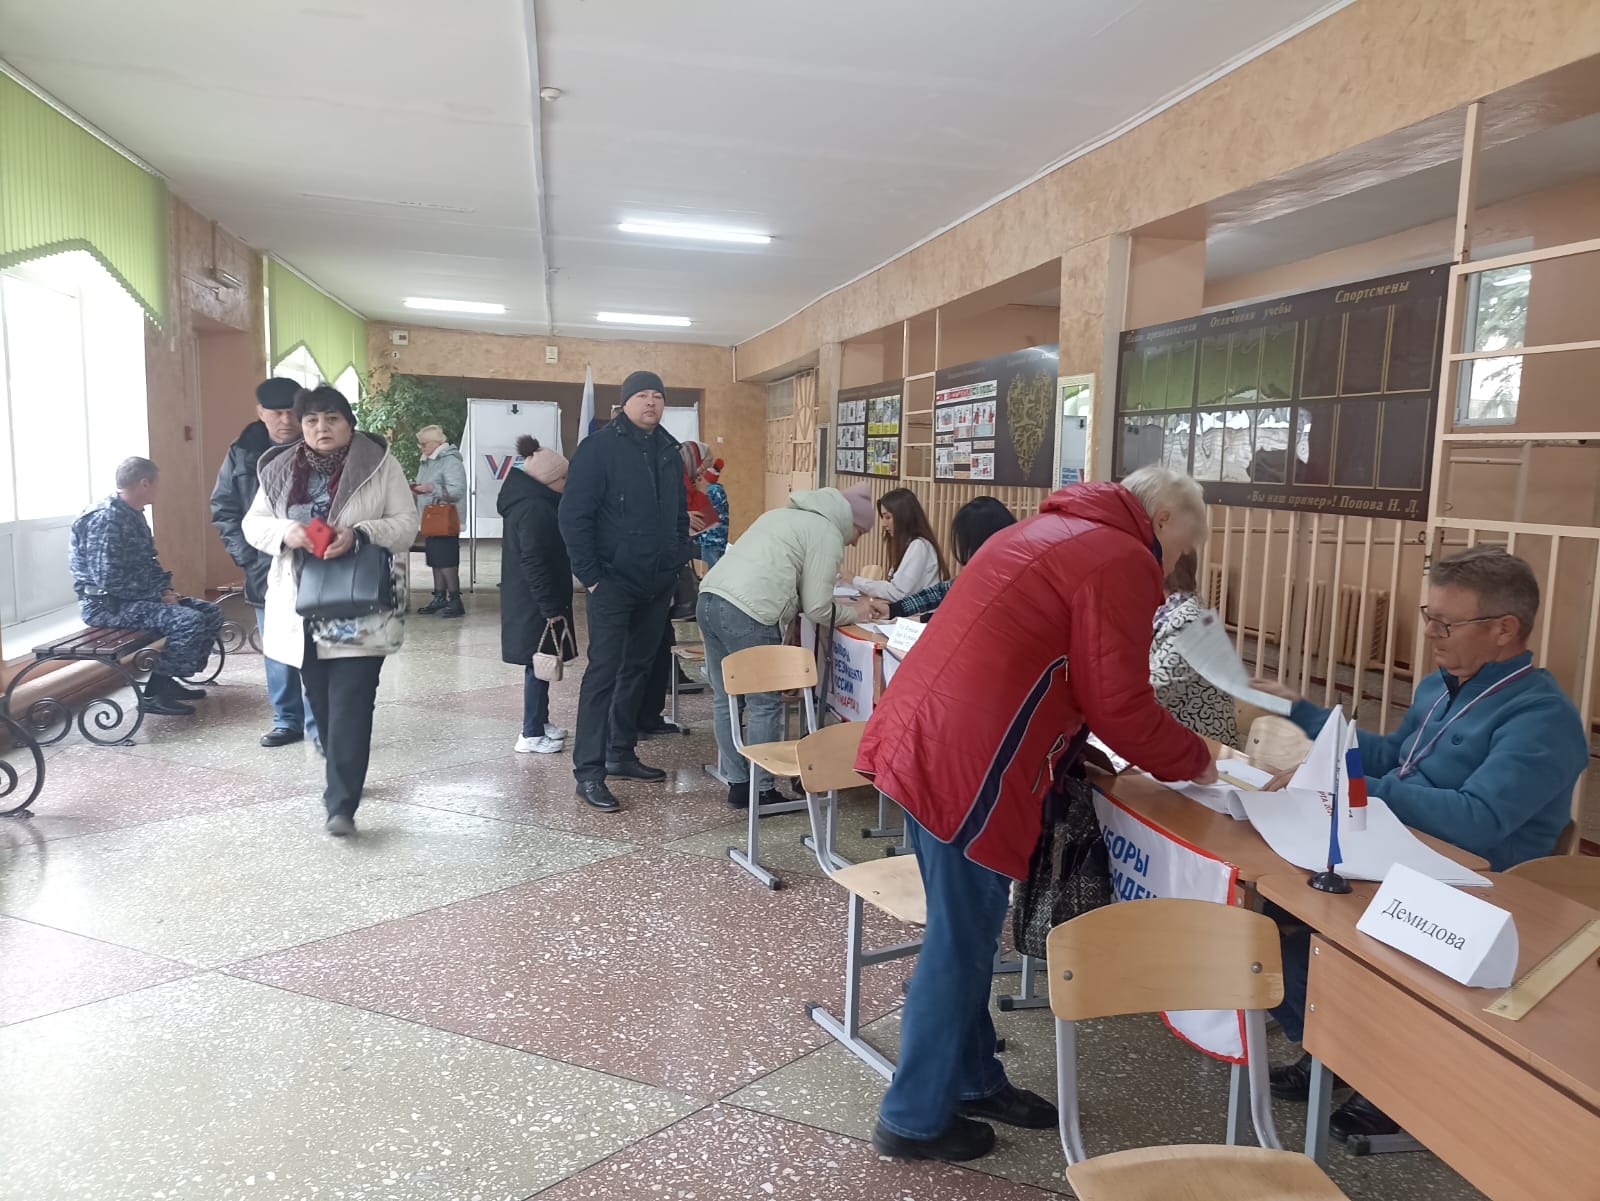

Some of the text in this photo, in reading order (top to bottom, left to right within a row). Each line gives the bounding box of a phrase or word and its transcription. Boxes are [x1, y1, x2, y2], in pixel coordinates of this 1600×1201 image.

[1335, 281, 1410, 304] Спортсмены
[1340, 495, 1385, 512] Попова
[1387, 498, 1402, 513] Н.
[1381, 898, 1467, 951] Демидова
